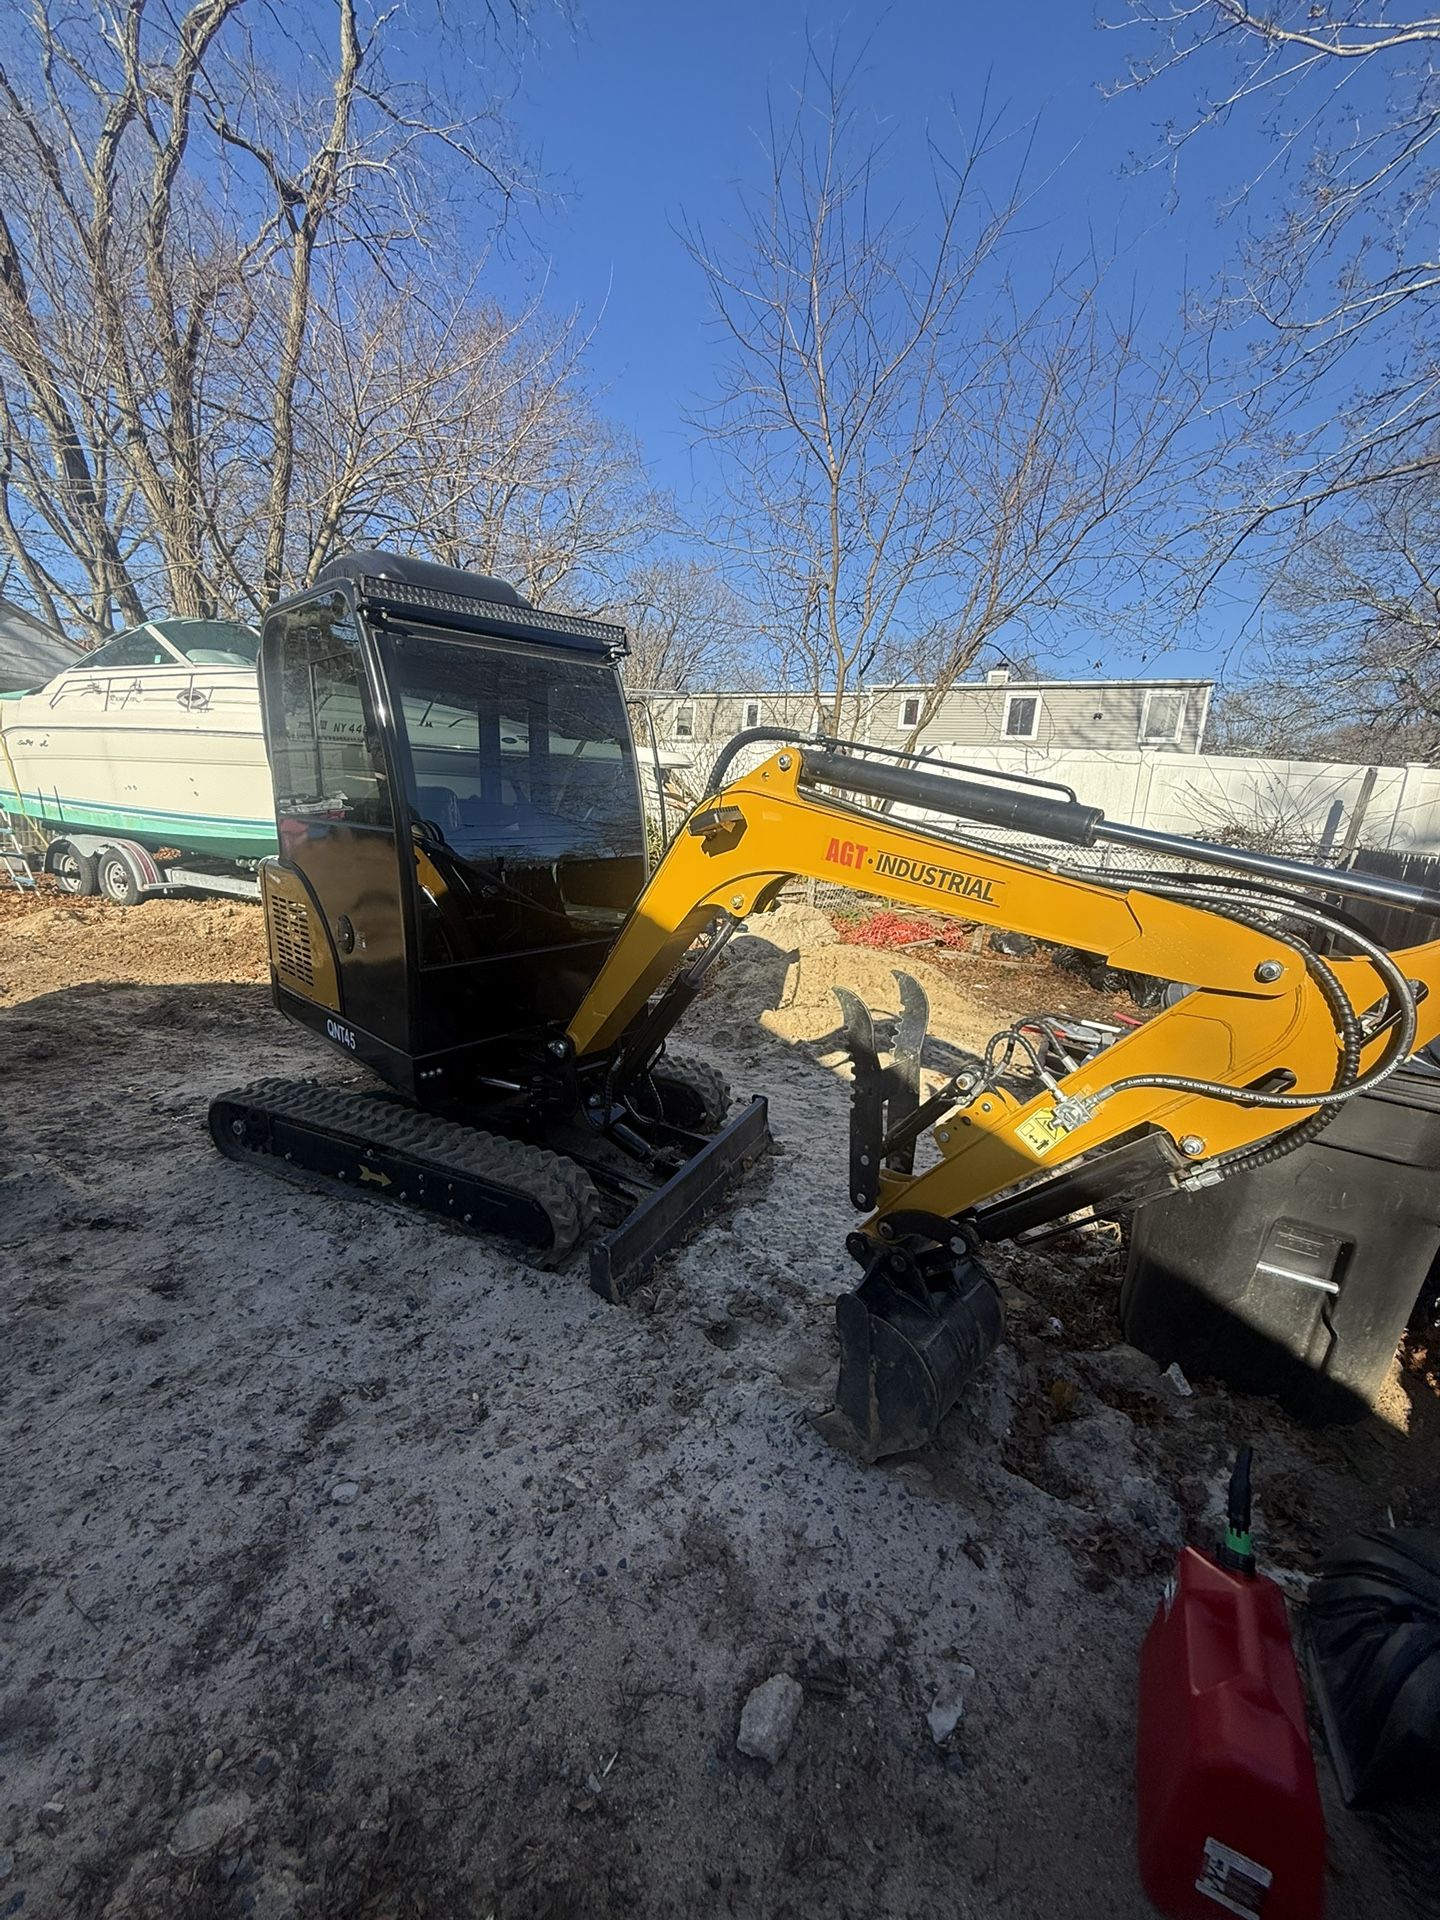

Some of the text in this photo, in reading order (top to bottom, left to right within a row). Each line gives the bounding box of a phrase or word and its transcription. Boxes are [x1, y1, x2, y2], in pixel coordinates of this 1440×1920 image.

[333, 722, 347, 733] NY
[825, 838, 994, 902] AGT INDUSTRIAL
[326, 1018, 356, 1050] QNT45
